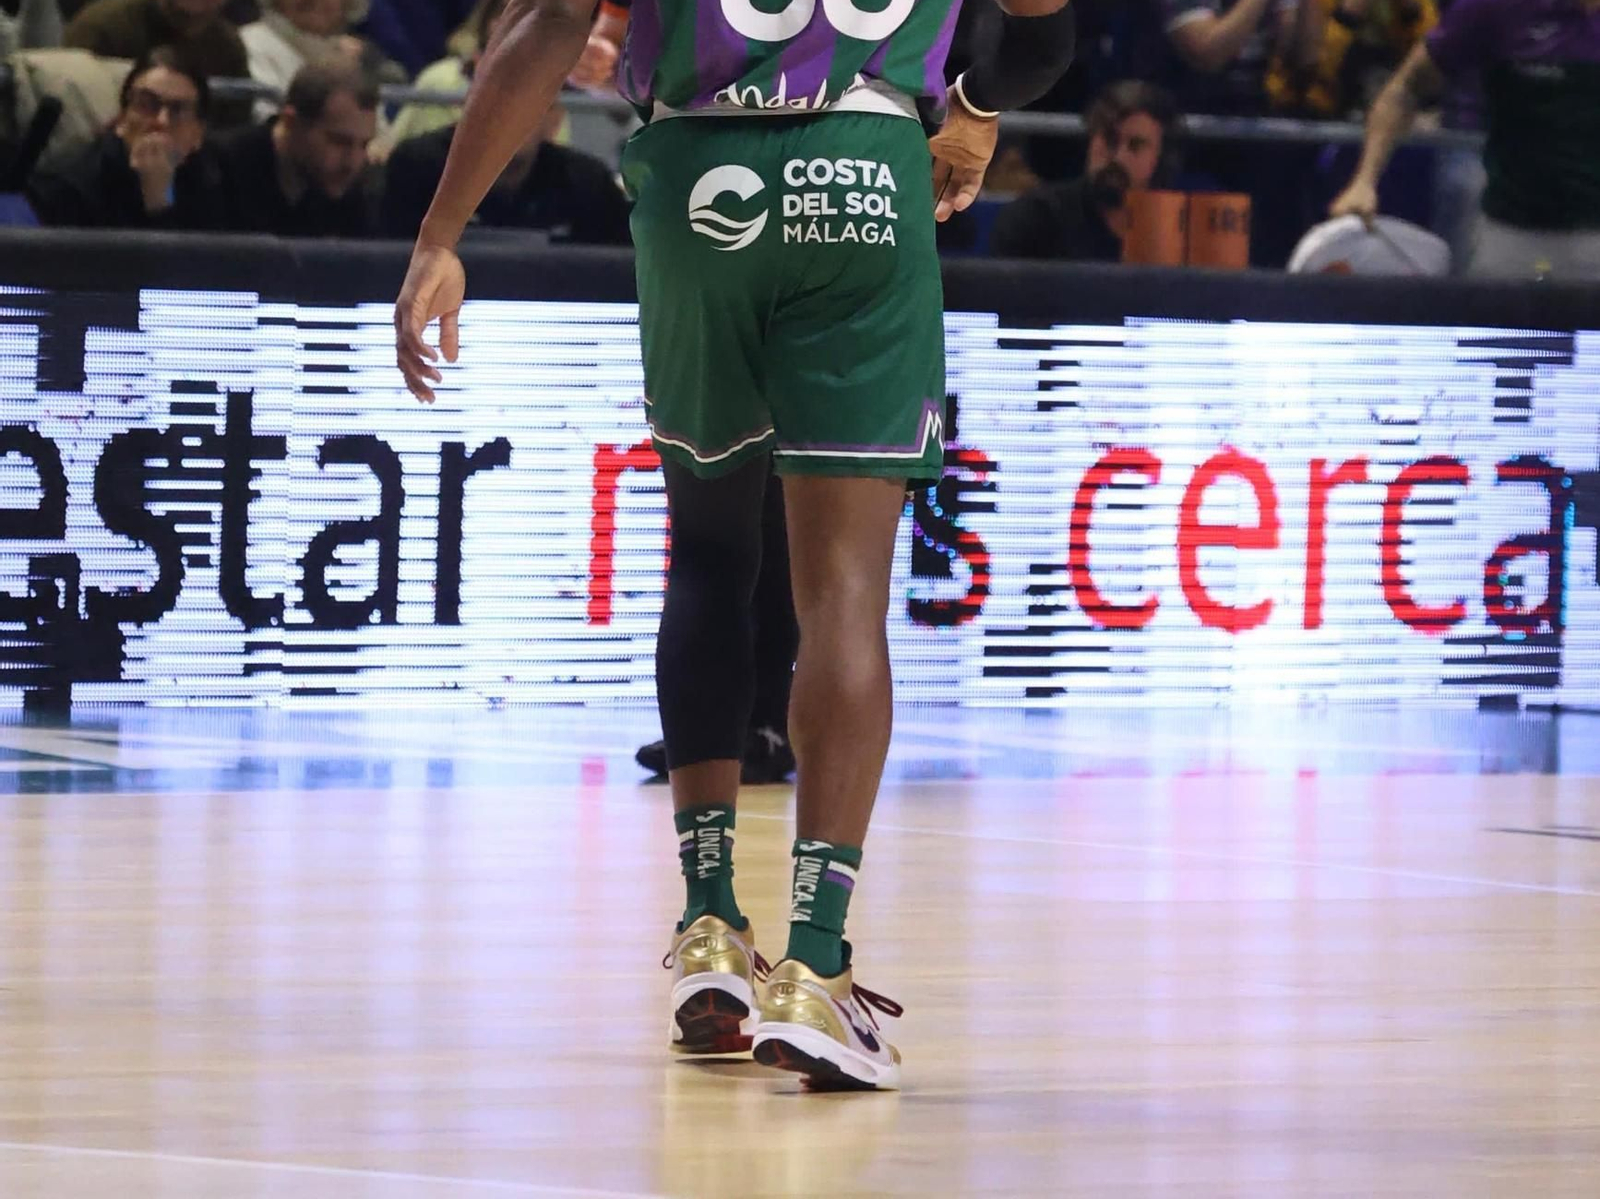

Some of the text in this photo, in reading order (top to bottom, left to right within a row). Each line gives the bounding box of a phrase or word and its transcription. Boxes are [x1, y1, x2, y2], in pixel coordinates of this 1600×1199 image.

[783, 158, 897, 192] COSTA
[782, 191, 898, 220] DEL SOL
[783, 217, 896, 247] MÁLAGA
[1067, 443, 1575, 638] cerca
